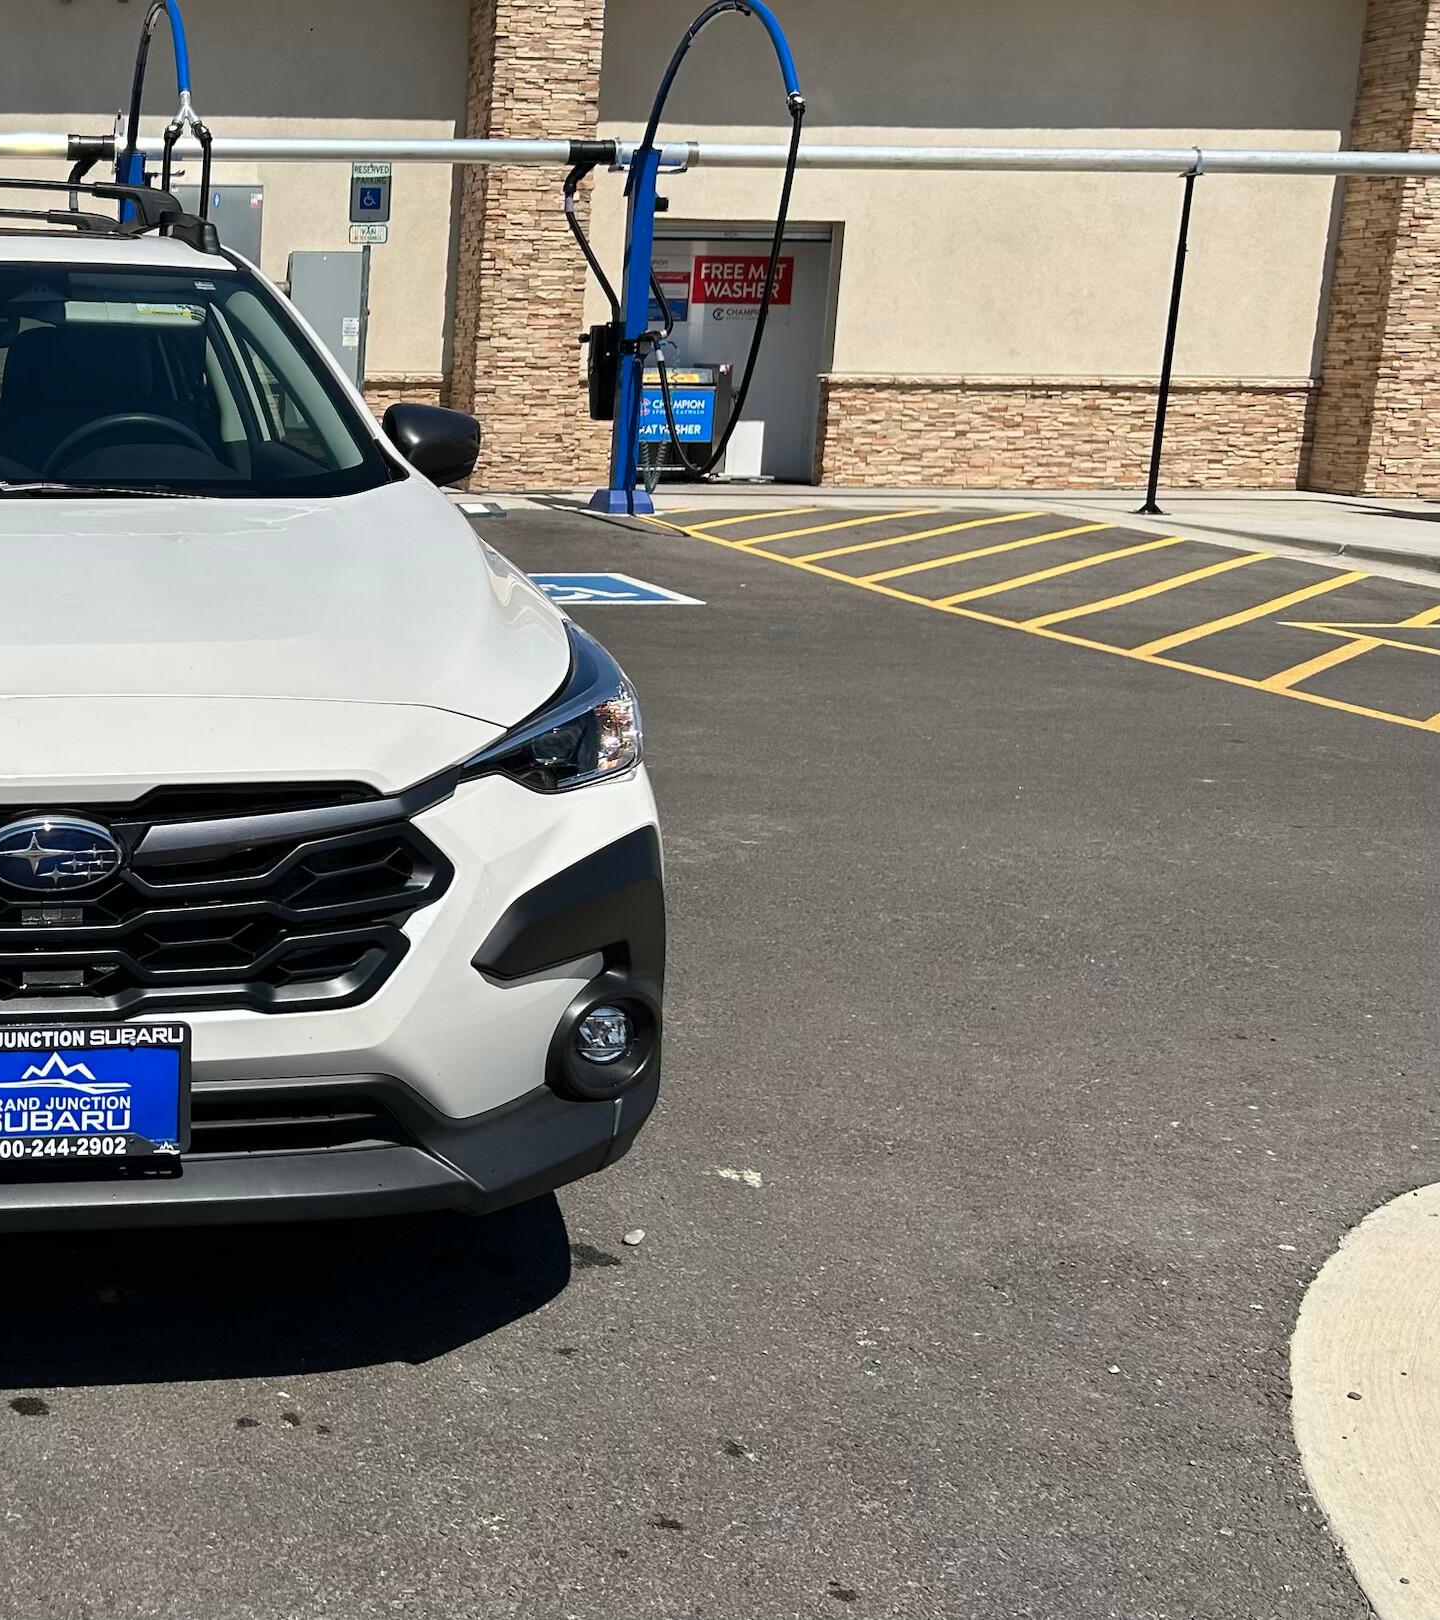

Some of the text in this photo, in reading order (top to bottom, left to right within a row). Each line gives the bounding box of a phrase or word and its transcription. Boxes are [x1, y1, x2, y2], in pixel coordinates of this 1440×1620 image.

[354, 165, 389, 174] RESERVED
[700, 262, 744, 280] FREE
[704, 281, 780, 299] WASHER
[652, 399, 705, 409] CHMPION
[89, 1027, 184, 1046] SUBARU
[45, 1096, 131, 1110] JUNCTION
